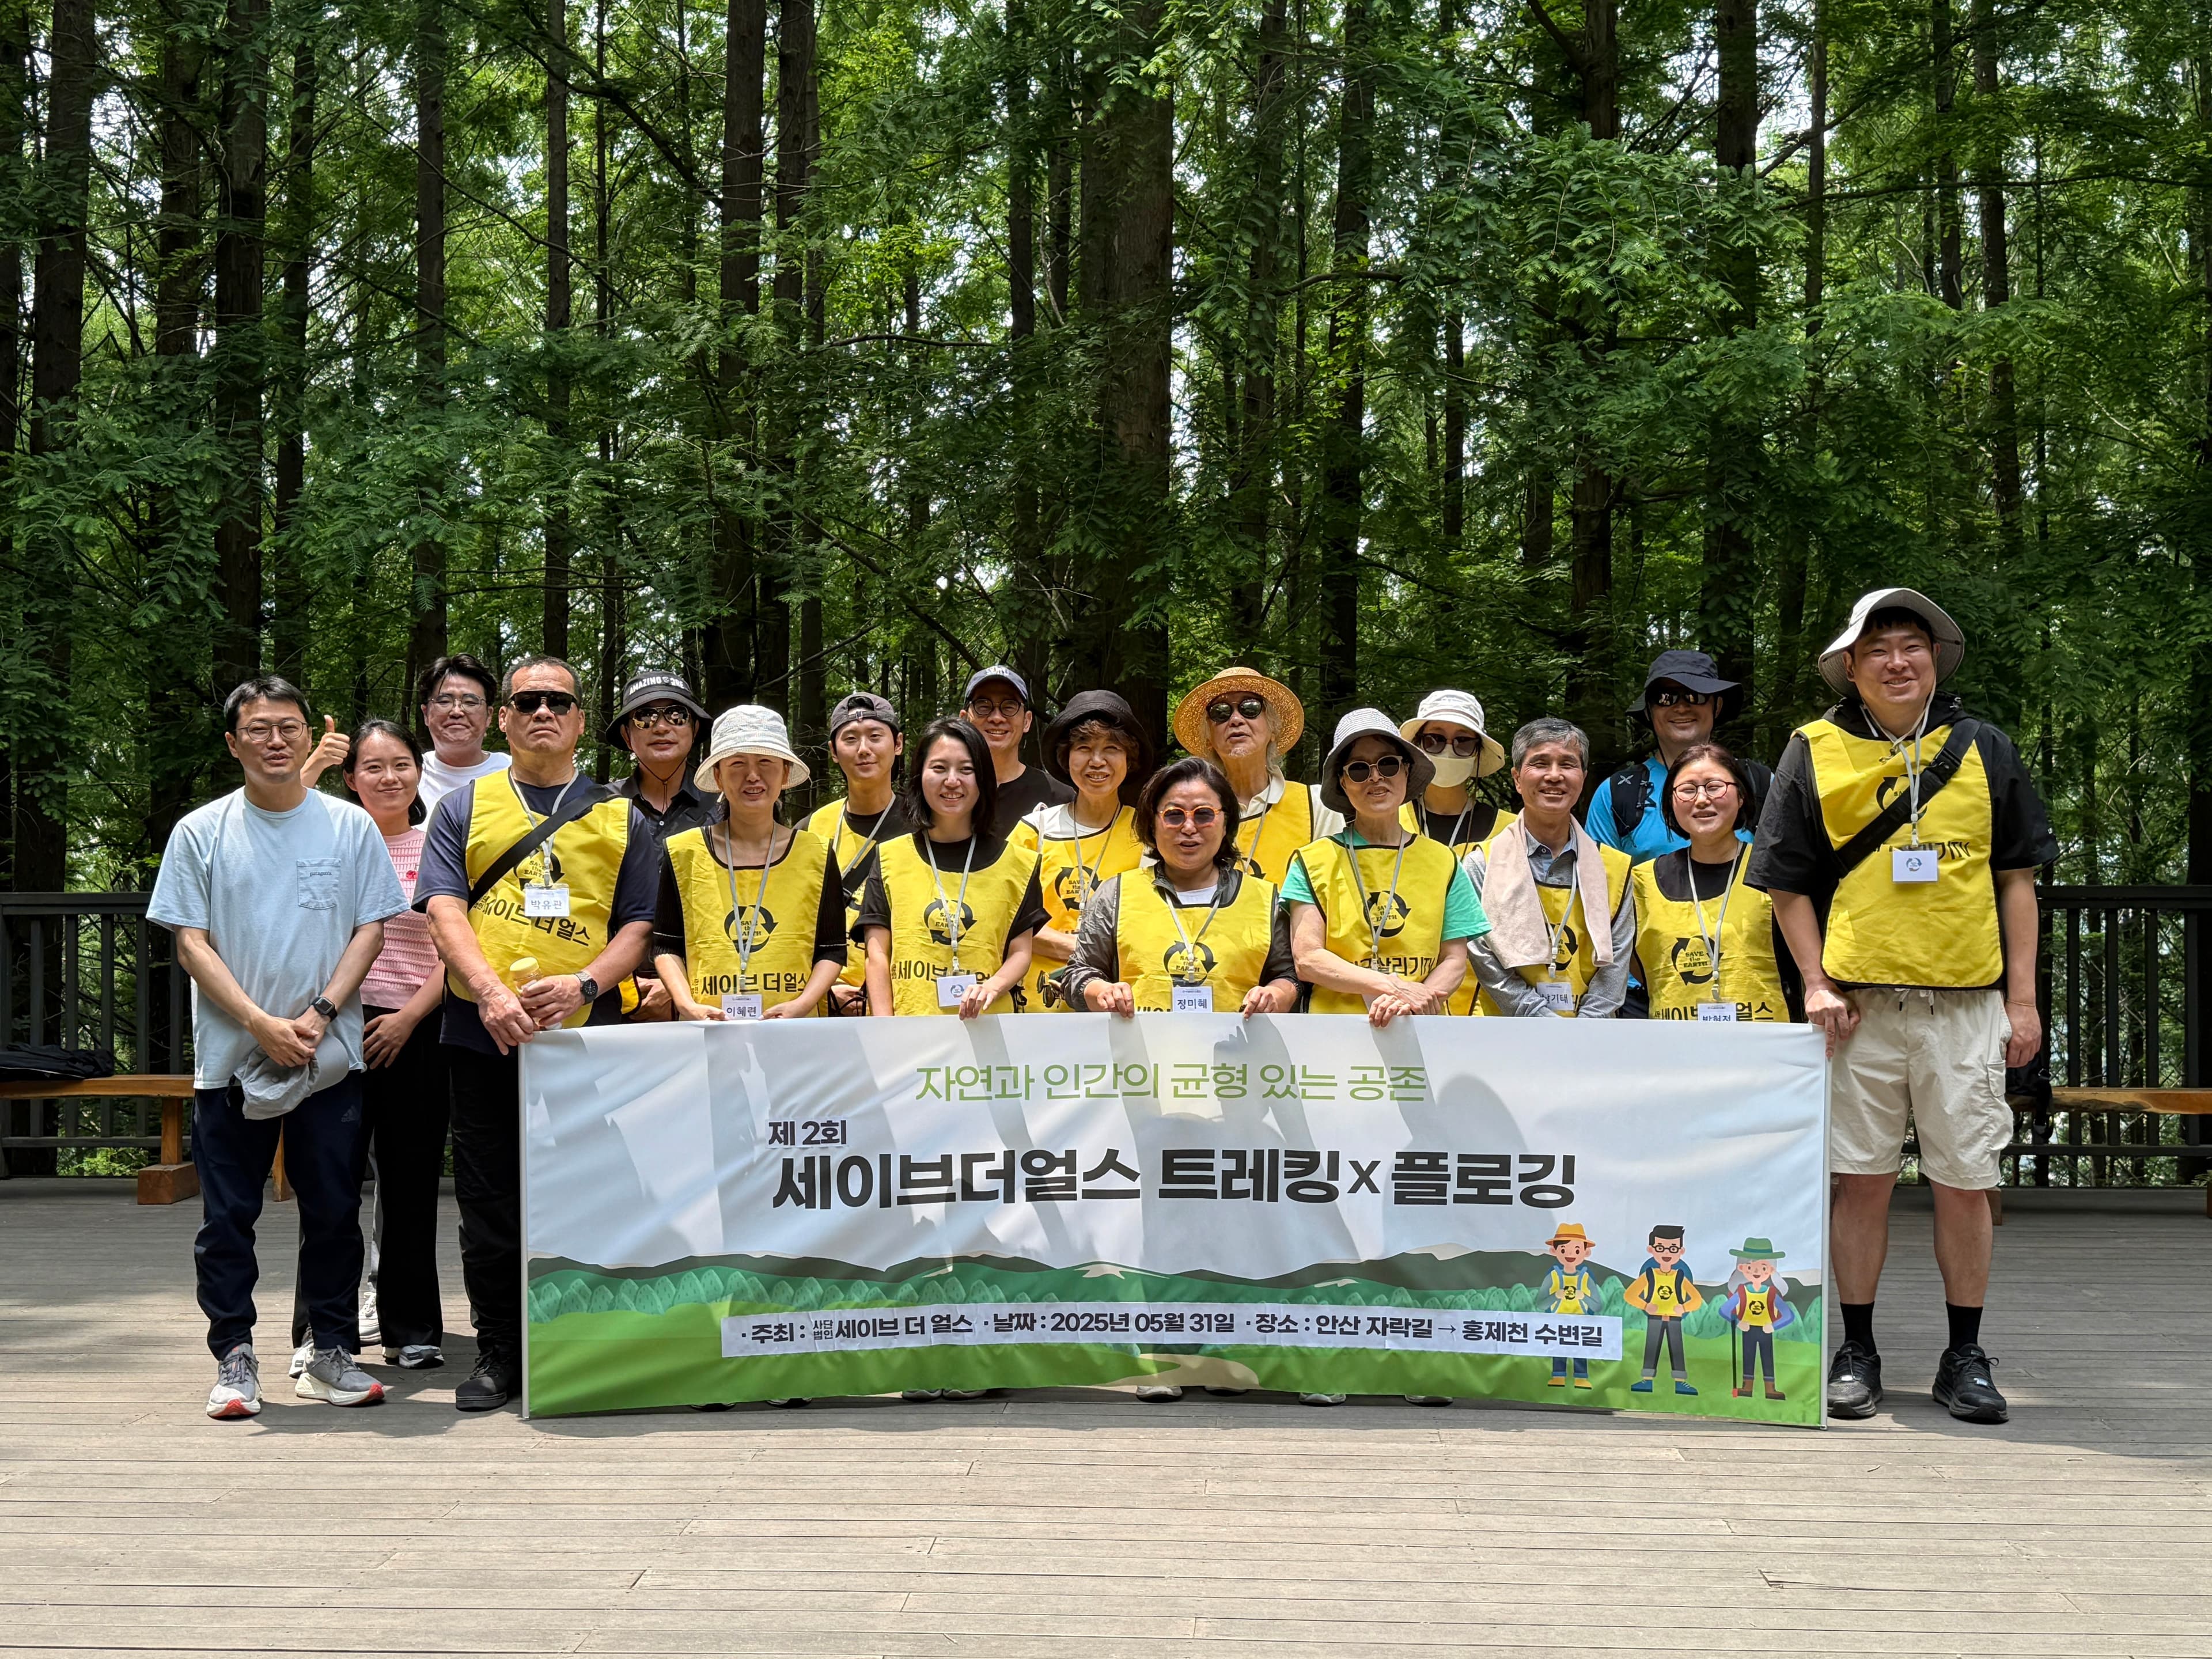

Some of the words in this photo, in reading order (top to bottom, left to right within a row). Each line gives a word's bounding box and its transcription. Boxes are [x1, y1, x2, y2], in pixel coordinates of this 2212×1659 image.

[531, 900, 562, 910] 박유관
[556, 918, 590, 946] 얼스
[763, 972, 781, 993] 더
[726, 1006, 756, 1017] 이혜련
[1177, 998, 1207, 1010] 정미혜
[916, 1065, 1035, 1101] 자연과
[1044, 1063, 1158, 1100] 인간의
[1171, 1063, 1248, 1099] 균형
[1260, 1064, 1338, 1100] 있는
[1347, 1066, 1427, 1101] 공존
[768, 1120, 795, 1146] 제
[801, 1119, 847, 1146] 2회
[772, 1148, 1141, 1210] 세이브더얼스
[813, 1320, 834, 1330] 사단
[835, 1318, 900, 1339] 세이브
[905, 1316, 925, 1335] 더
[930, 1313, 974, 1334] 얼스
[1050, 1313, 1130, 1332] 2025년
[1134, 1313, 1185, 1333] 05월
[1189, 1313, 1235, 1333] 31일
[1316, 1315, 1361, 1335] 안산
[1366, 1316, 1433, 1339] 자락길
[1461, 1320, 1529, 1343] 홍제천
[1535, 1324, 1603, 1347] 수변길
[813, 1330, 834, 1340] 법인
